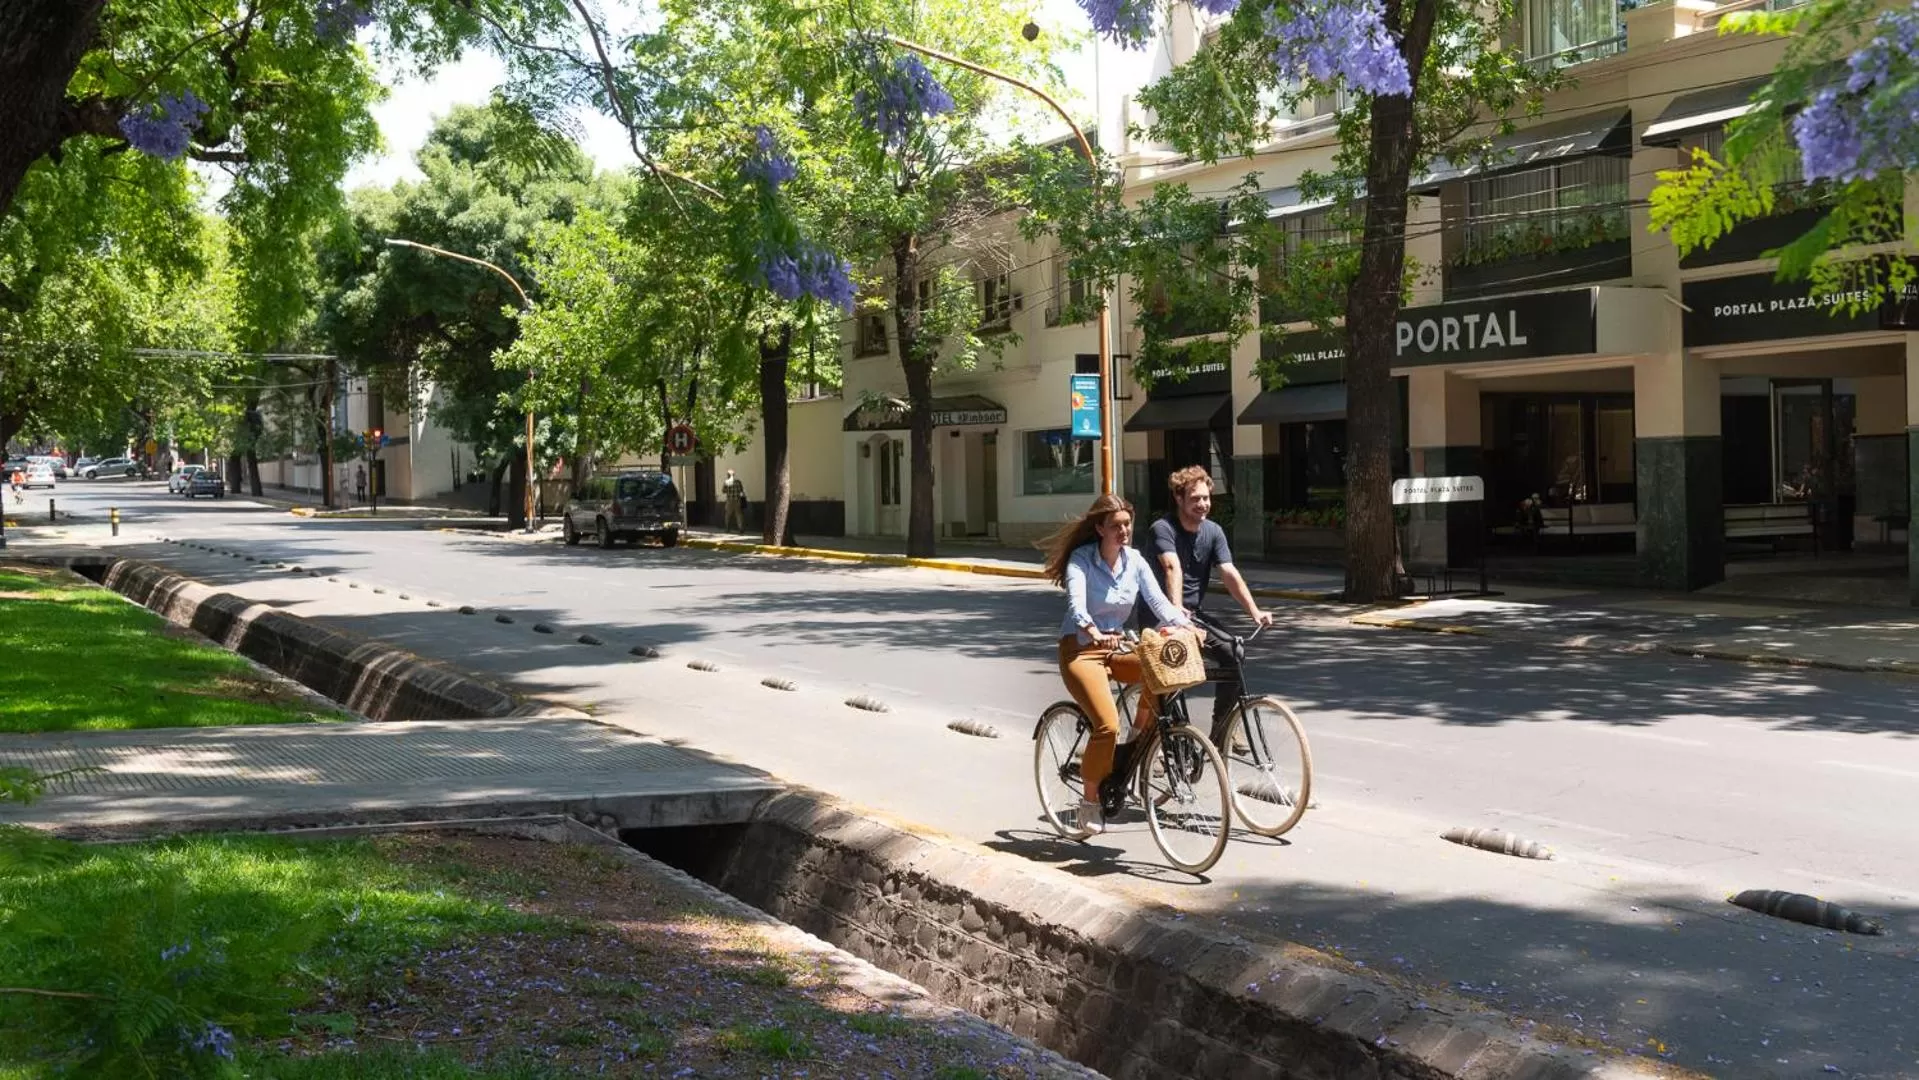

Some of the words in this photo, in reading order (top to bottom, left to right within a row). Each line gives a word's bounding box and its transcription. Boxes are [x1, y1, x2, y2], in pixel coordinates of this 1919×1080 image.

[1714, 303, 1765, 317] PORTAL
[1770, 297, 1816, 311] PLAZA
[1823, 290, 1870, 304] SUITES
[1396, 310, 1527, 356] PORTAL
[1318, 349, 1346, 360] PLAZA
[1202, 362, 1225, 373] SUITES
[930, 411, 955, 424] OTEL
[675, 431, 688, 448] H
